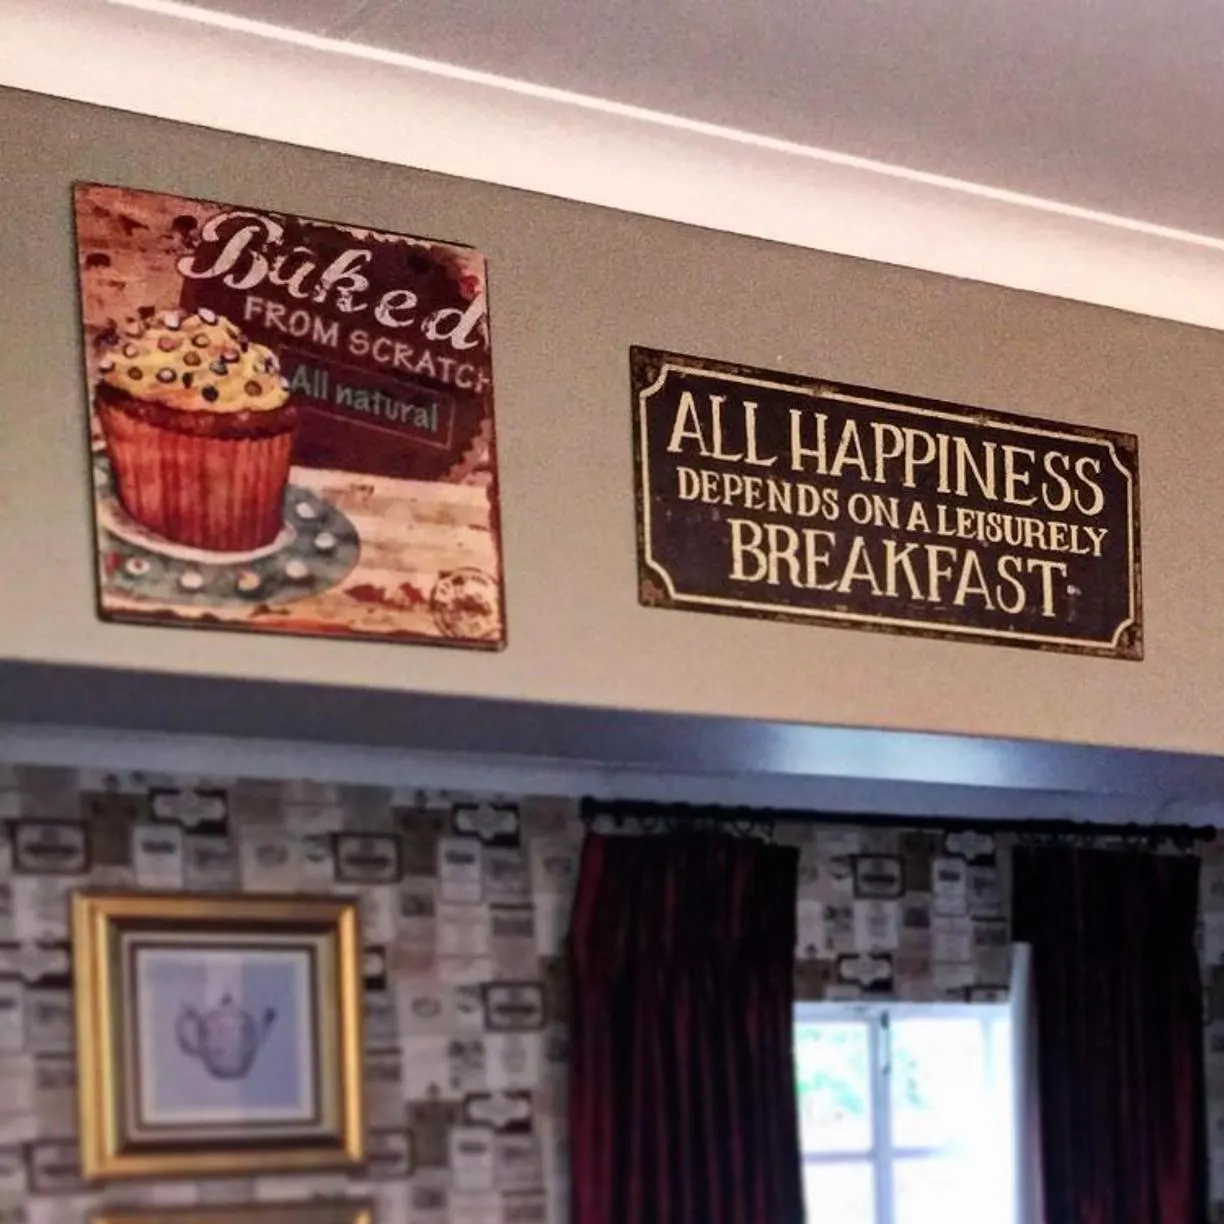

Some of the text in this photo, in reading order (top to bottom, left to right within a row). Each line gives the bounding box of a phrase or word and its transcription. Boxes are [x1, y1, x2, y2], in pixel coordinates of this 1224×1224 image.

[177, 211, 490, 350] Baked
[244, 297, 338, 346] FROM
[290, 363, 438, 432] All natural
[667, 391, 1104, 516] ALL HAPPINESS
[676, 466, 1108, 557] DEPENDS ON A LEISURELY
[728, 519, 1067, 617] BREAKFAST
